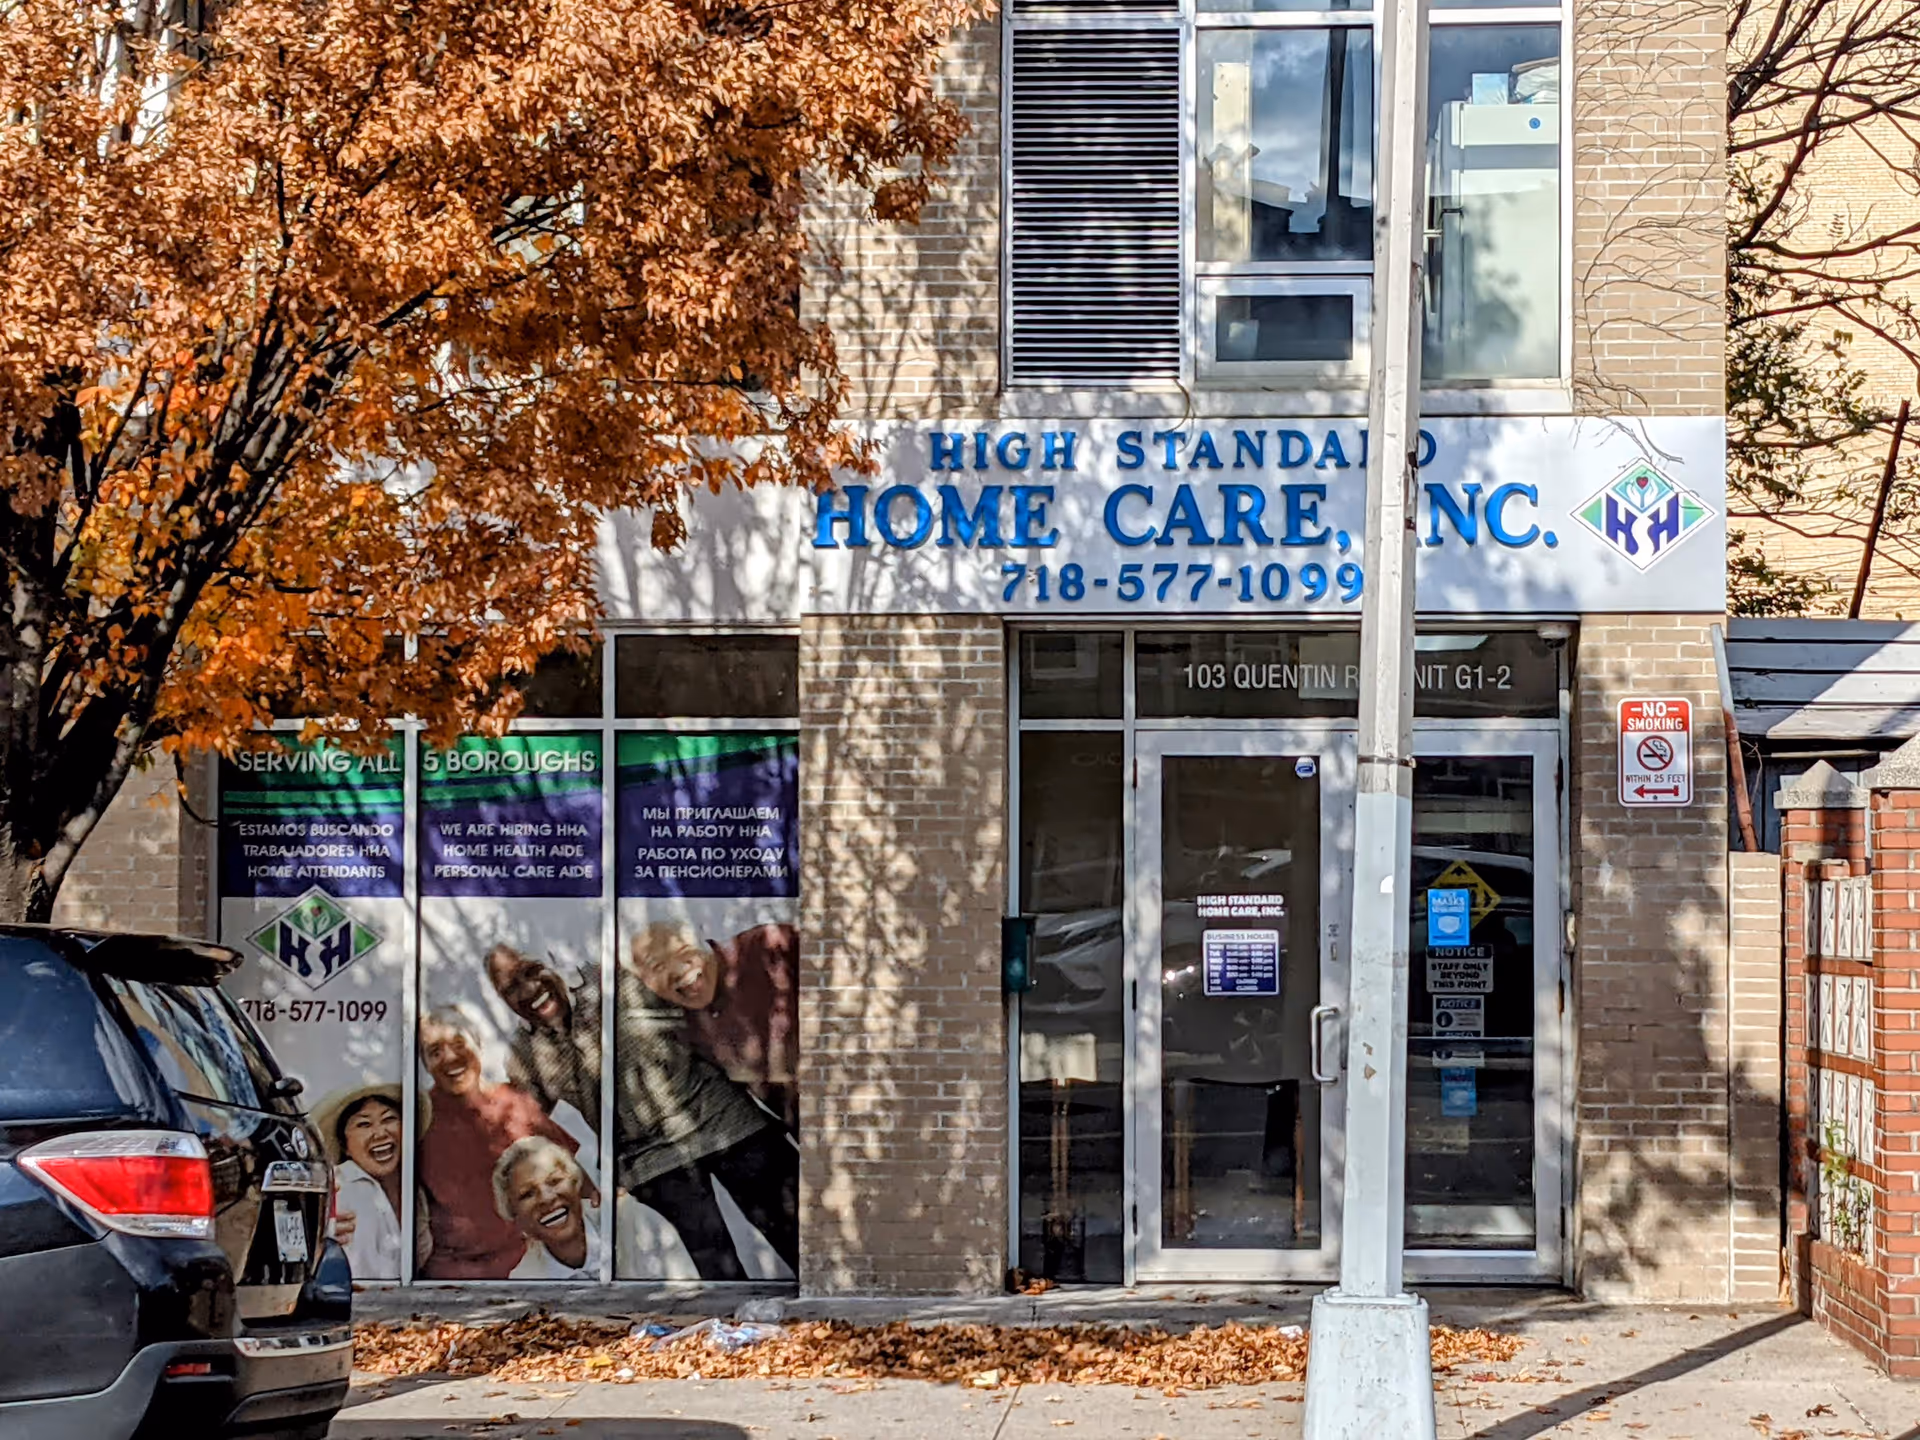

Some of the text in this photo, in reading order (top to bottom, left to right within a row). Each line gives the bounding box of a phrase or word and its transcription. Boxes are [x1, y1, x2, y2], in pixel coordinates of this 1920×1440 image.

[929, 430, 1437, 471] HIGH STANDAD
[812, 483, 1558, 554] HOME CARE, NC.
[1002, 563, 1363, 603] 718-577-1099
[1183, 664, 1226, 690] 103
[1233, 664, 1336, 690] QUENTIN
[1414, 665, 1448, 689] NIT
[1455, 664, 1512, 690] G1-2
[1642, 702, 1667, 717] NO
[1627, 717, 1683, 730] SMOKING
[239, 750, 597, 772] SERVING ALL 5 BOROUGHS
[1625, 774, 1685, 783] WITHIN 25 FEET
[643, 807, 780, 820] МЫ ПРИГЛАШАЕМ
[239, 824, 394, 836] ESTAMOS BUSCANDO
[440, 824, 588, 836] WE ARE HIRING HHA
[651, 825, 672, 837] НА
[677, 825, 735, 837] РАБОТУ
[243, 845, 391, 857] TRABAJADORES HHA
[443, 845, 584, 857] HOME HEALTH AIDE
[638, 848, 784, 862] РАБОТА ПО УХОДУ
[248, 865, 385, 878] HOME ATTENDANTS
[434, 865, 593, 878] PERSONAL CARE AIDE
[634, 866, 788, 878] ЗА ПЕНСИОНЕРАМИ
[1197, 895, 1284, 905] HIGH STANDARD
[1198, 906, 1285, 917] HOME CARE, INC.
[1435, 947, 1485, 957] NOTICE
[1463, 963, 1489, 971] ONLY
[1440, 971, 1480, 979] BEYOND
[1440, 1000, 1476, 1009] NOTICE
[244, 1000, 387, 1022] 718-577-1099
